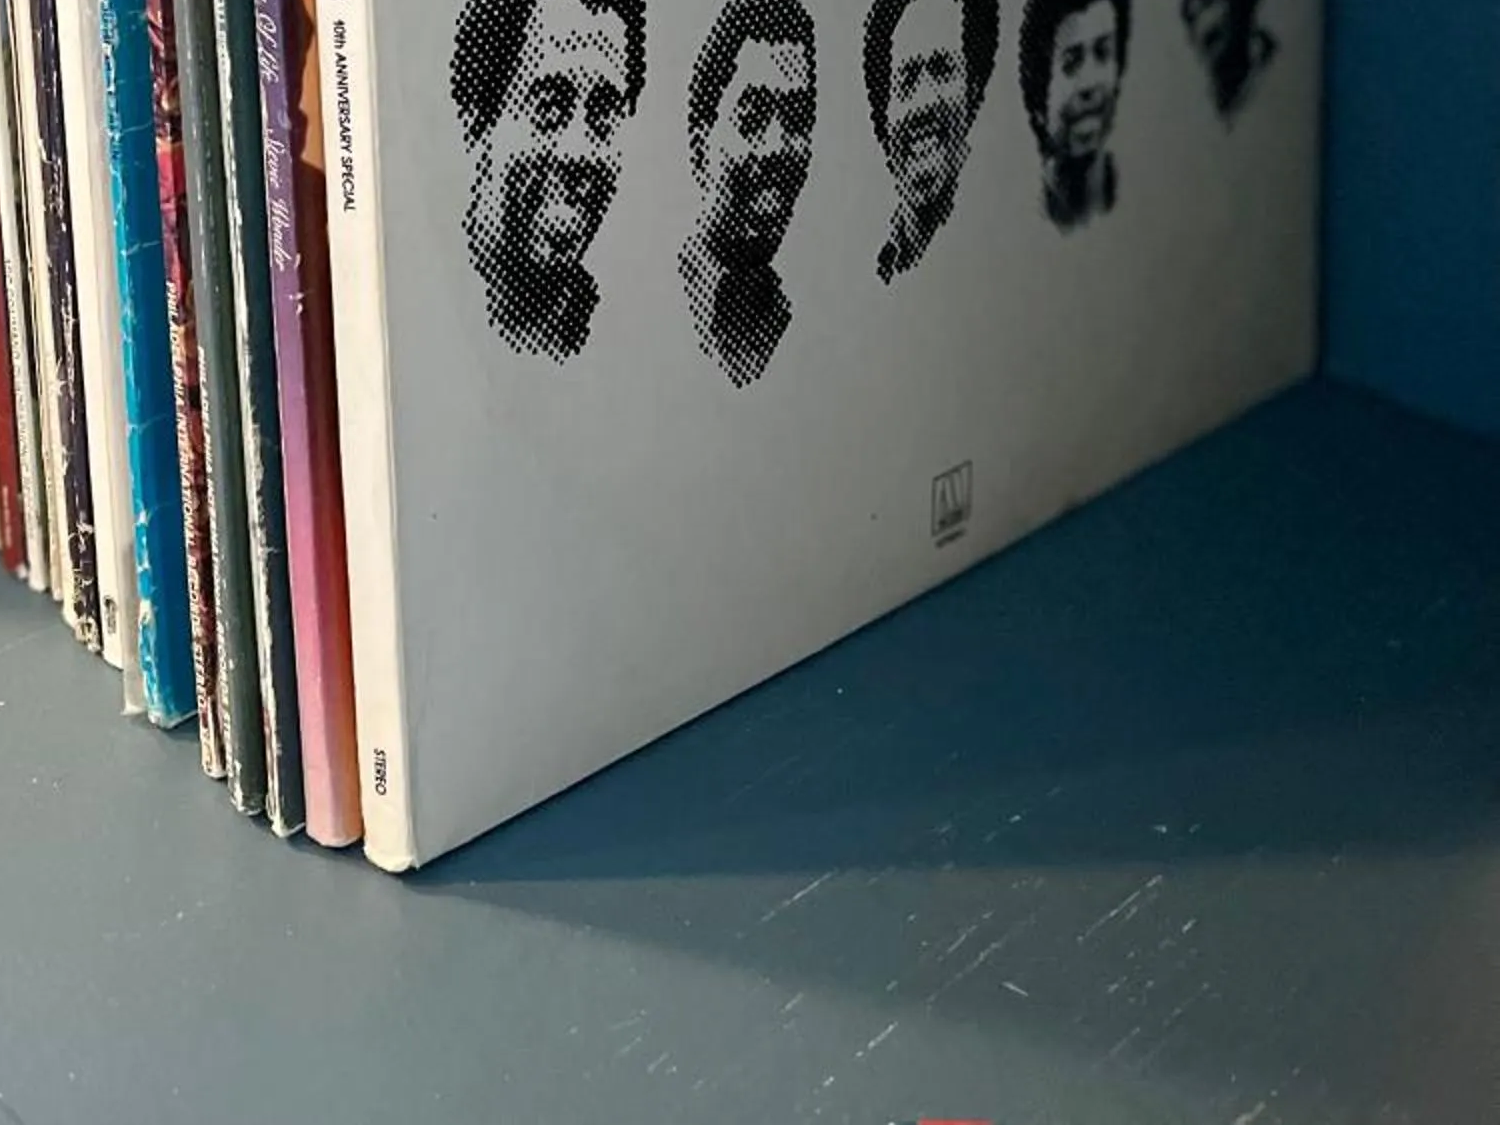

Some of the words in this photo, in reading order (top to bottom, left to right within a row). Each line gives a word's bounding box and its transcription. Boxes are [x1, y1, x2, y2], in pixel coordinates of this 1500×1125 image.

[256, 11, 278, 52] Of
[259, 46, 281, 84] Life
[332, 19, 348, 50] 10th
[334, 51, 354, 154] ANNIVERSARY
[265, 127, 286, 190] Stevie
[340, 154, 357, 213] SPECIAL
[270, 197, 293, 273] Wonder
[166, 280, 185, 407] PHILADELPHIA
[197, 345, 214, 474] PHILADELPHIA
[176, 411, 197, 547] INTERNATIONAL
[187, 553, 202, 638] RECORDS
[193, 641, 208, 710] STEREO
[372, 748, 388, 797] STEREO
